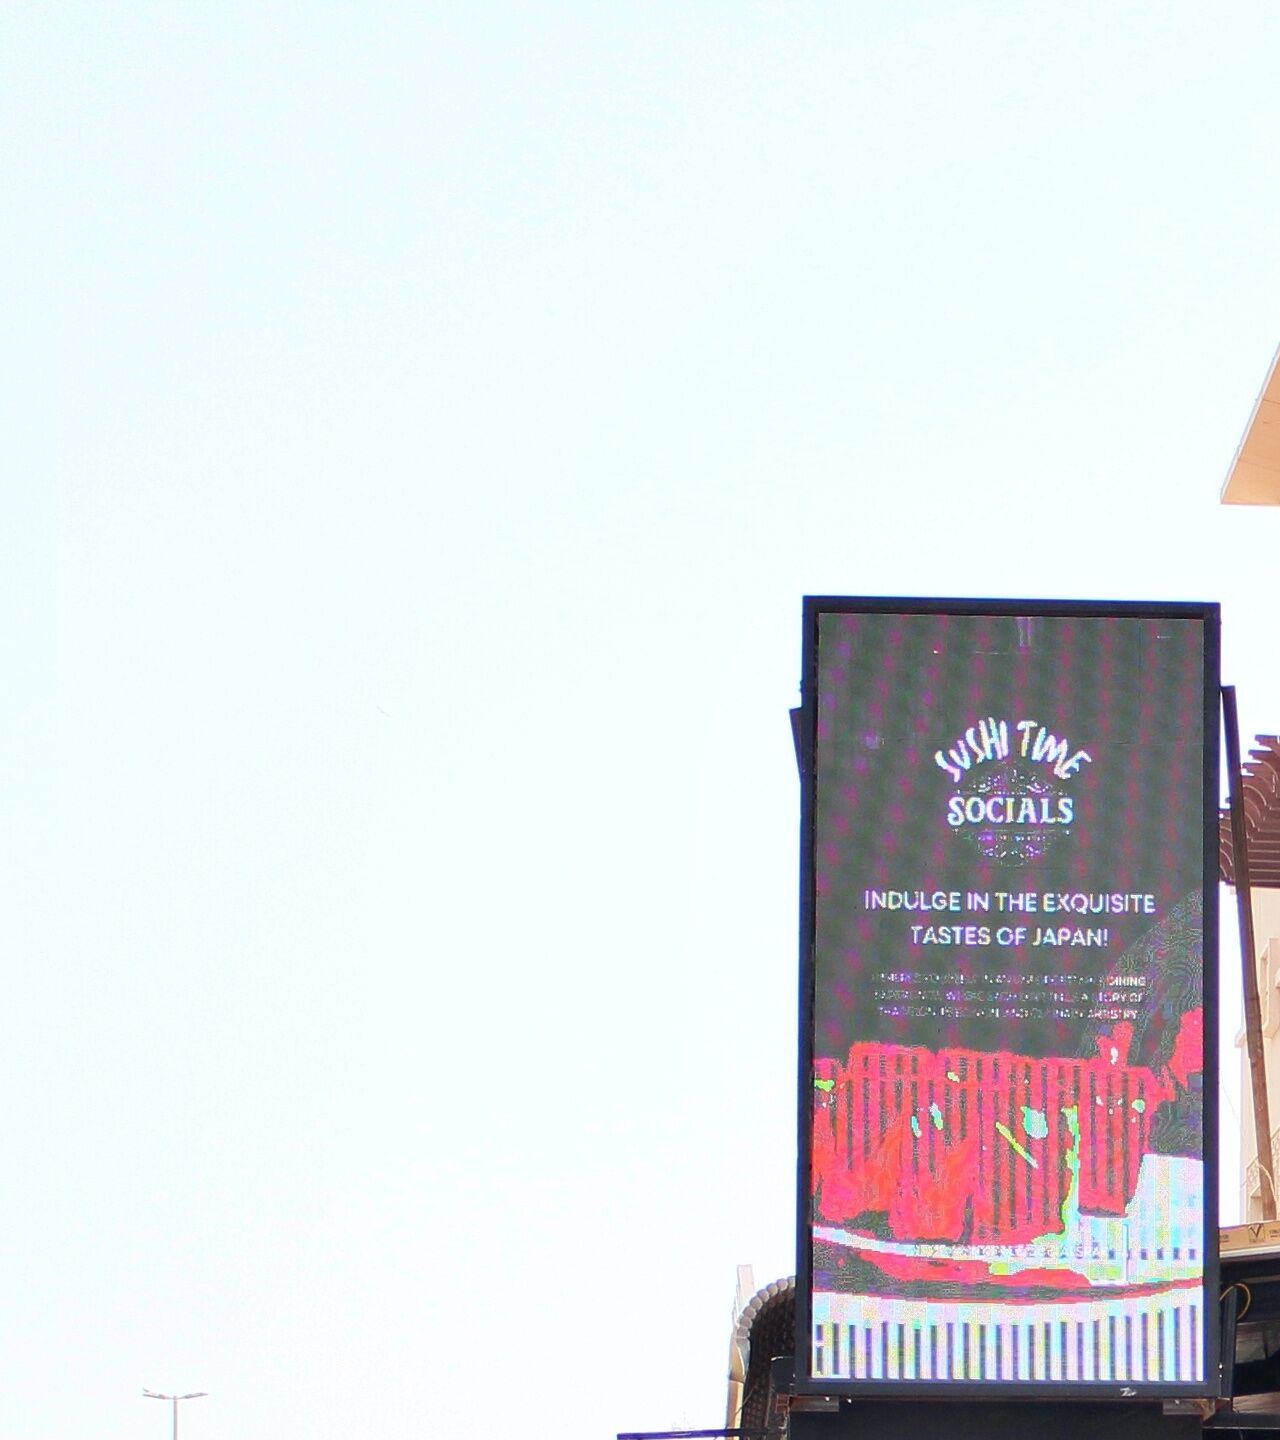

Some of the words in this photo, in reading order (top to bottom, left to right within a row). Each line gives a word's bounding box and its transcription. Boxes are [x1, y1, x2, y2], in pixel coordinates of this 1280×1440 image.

[935, 717, 1008, 782] SUSHI
[1017, 720, 1092, 779] TIME
[947, 796, 1074, 826] SOCIALS
[864, 890, 961, 911] INDULGE
[967, 892, 989, 911] IN
[995, 892, 1037, 912] THE
[1043, 893, 1156, 914] EXQUISITE
[911, 925, 991, 945] TASTES
[996, 927, 1026, 945] OF
[1032, 928, 1108, 946] JAPAN!
